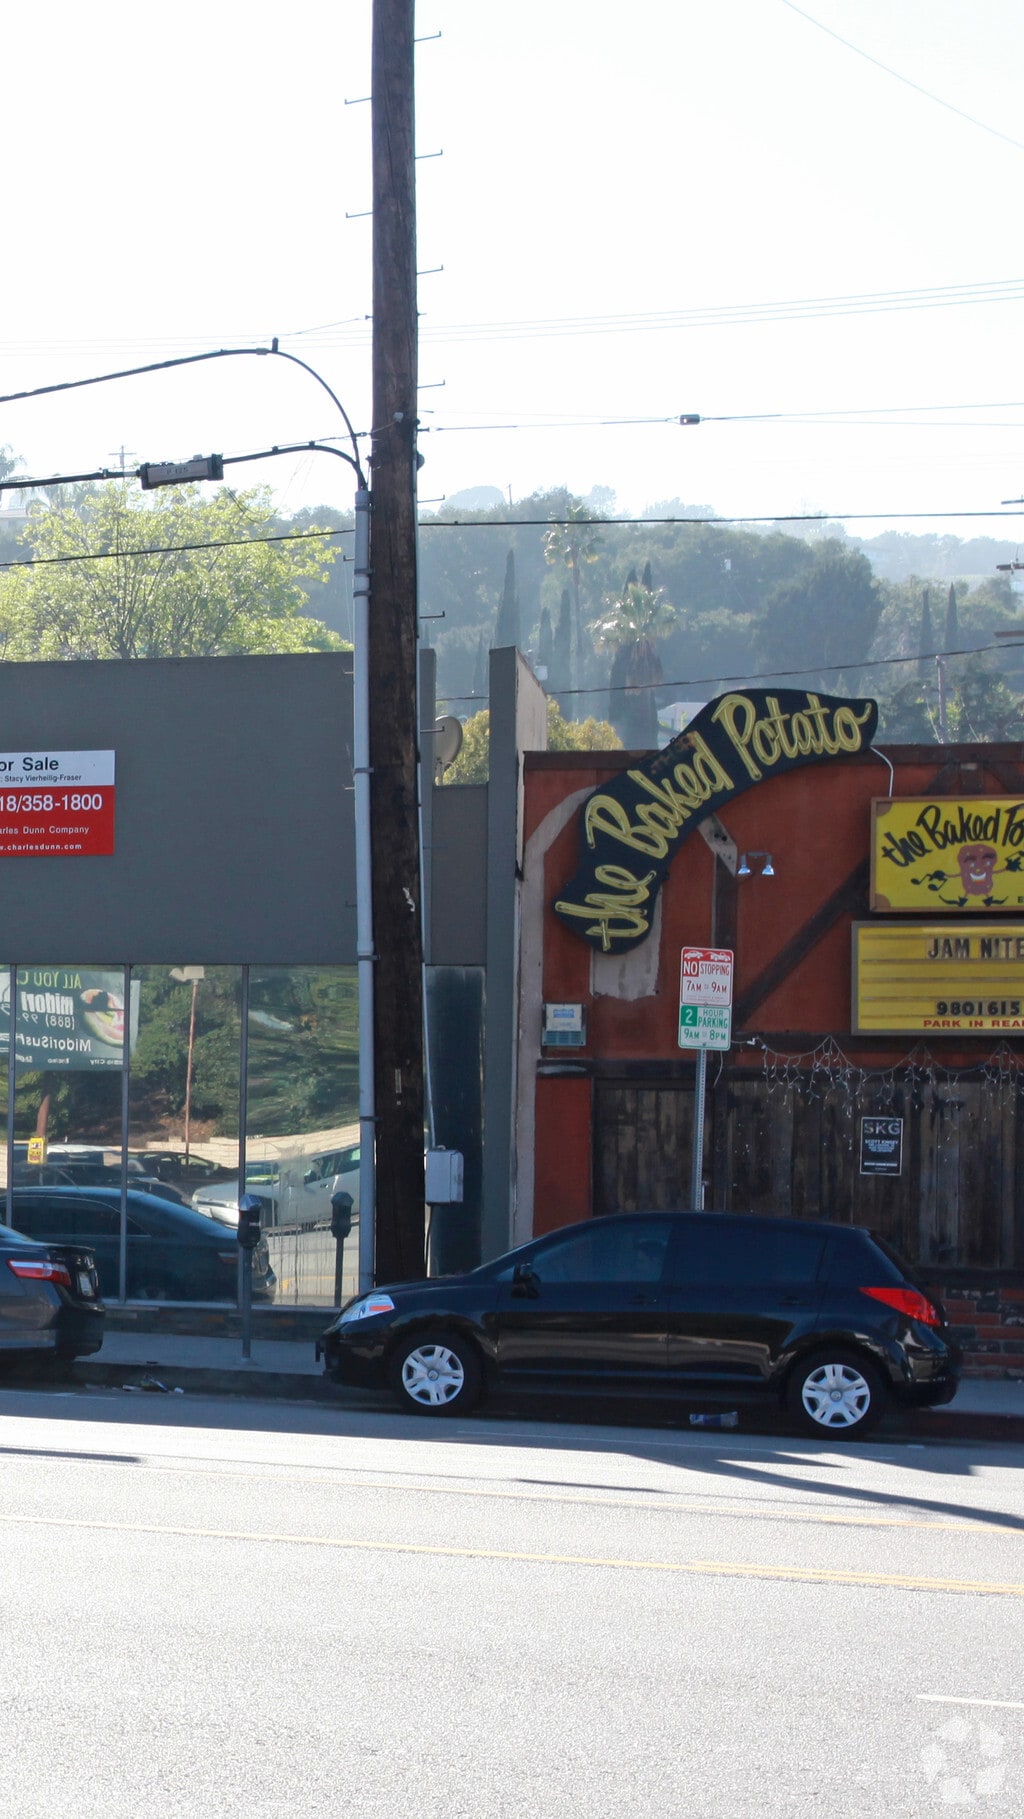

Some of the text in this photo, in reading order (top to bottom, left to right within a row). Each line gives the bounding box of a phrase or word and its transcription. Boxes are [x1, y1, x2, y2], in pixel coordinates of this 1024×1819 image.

[22, 756, 60, 772] Sale
[4, 775, 23, 784] Stacy
[555, 694, 872, 952] the Baked Potato
[23, 826, 45, 835] Dunn
[49, 825, 90, 835] Company
[881, 831, 933, 867] the
[915, 804, 1001, 850] Baked
[927, 937, 970, 958] JAM
[683, 960, 730, 976] NO STOPPING
[687, 980, 702, 992] 7AM
[711, 981, 727, 993] 9AM
[685, 1009, 724, 1024] 2 HOUR
[698, 1017, 728, 1029] PARKING
[923, 1019, 961, 1028] PARK
[969, 1019, 984, 1028] IN
[684, 1028, 700, 1039] 9AM
[709, 1029, 726, 1041] 8PM
[863, 1122, 901, 1135] SKG
